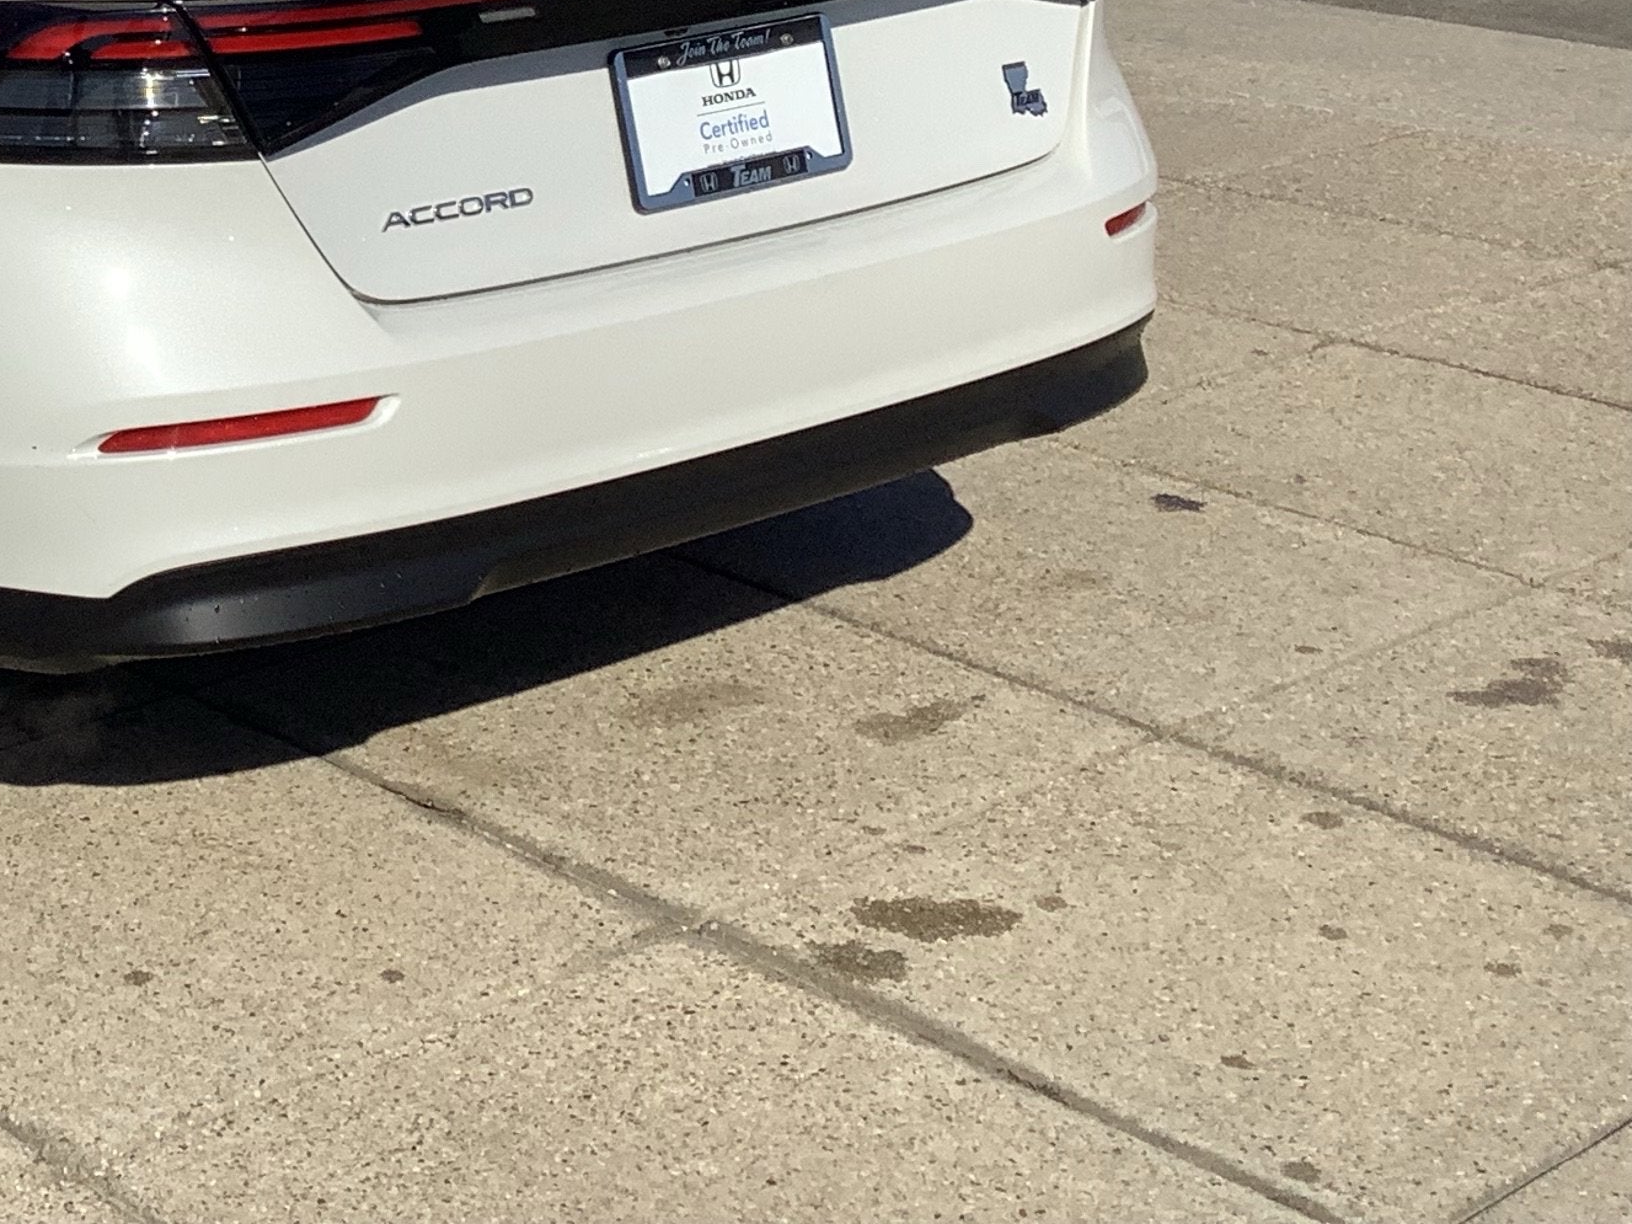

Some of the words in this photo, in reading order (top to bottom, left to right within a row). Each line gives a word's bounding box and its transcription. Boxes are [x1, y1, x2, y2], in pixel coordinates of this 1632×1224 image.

[676, 42, 706, 66] Join
[707, 36, 730, 55] The
[701, 87, 757, 107] HONDA
[700, 108, 770, 140] Certified
[703, 130, 773, 154] Pre-Owned
[381, 187, 534, 233] ACCORD
